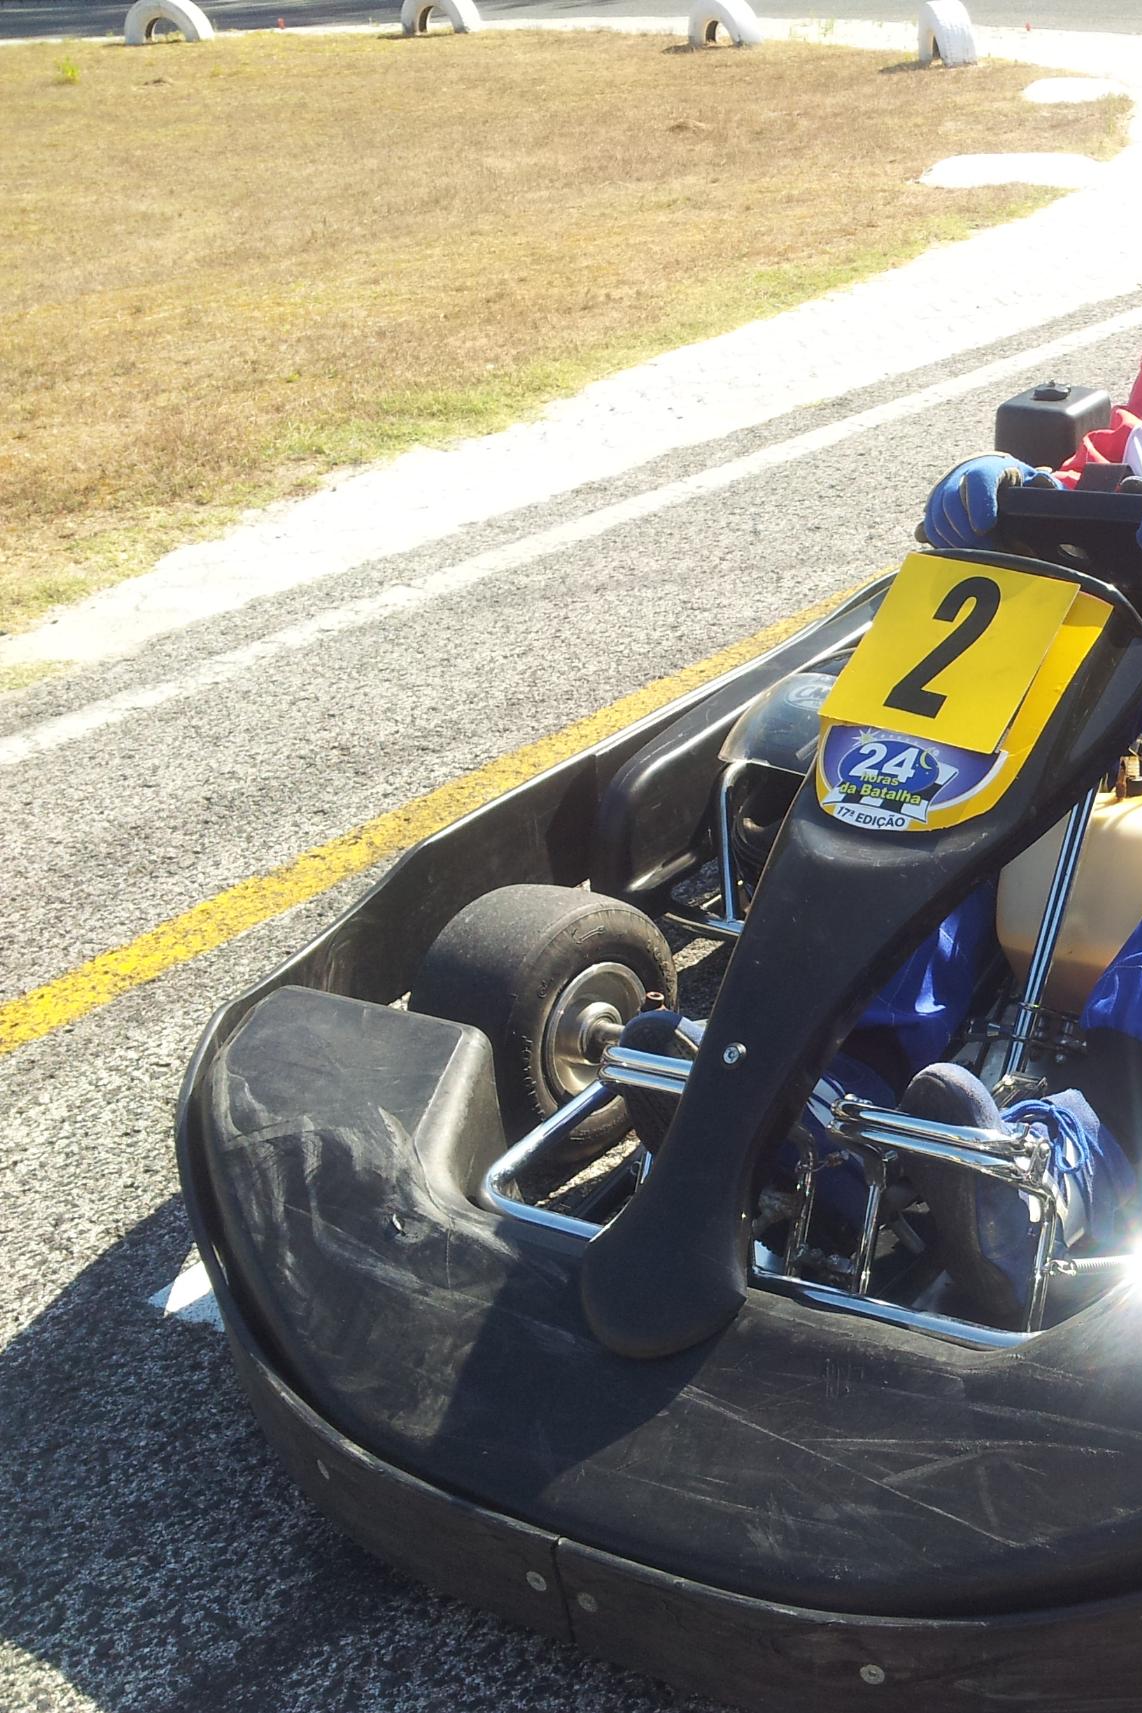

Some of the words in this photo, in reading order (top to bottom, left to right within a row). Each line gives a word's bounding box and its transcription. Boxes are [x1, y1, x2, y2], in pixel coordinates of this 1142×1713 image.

[882, 576, 1001, 719] 2
[848, 742, 920, 783] 24
[860, 771, 900, 786] horas
[839, 782, 856, 794] da
[860, 784, 922, 805] Batalha
[836, 806, 855, 818] 17ª
[855, 812, 906, 828] EDIÇÃO
